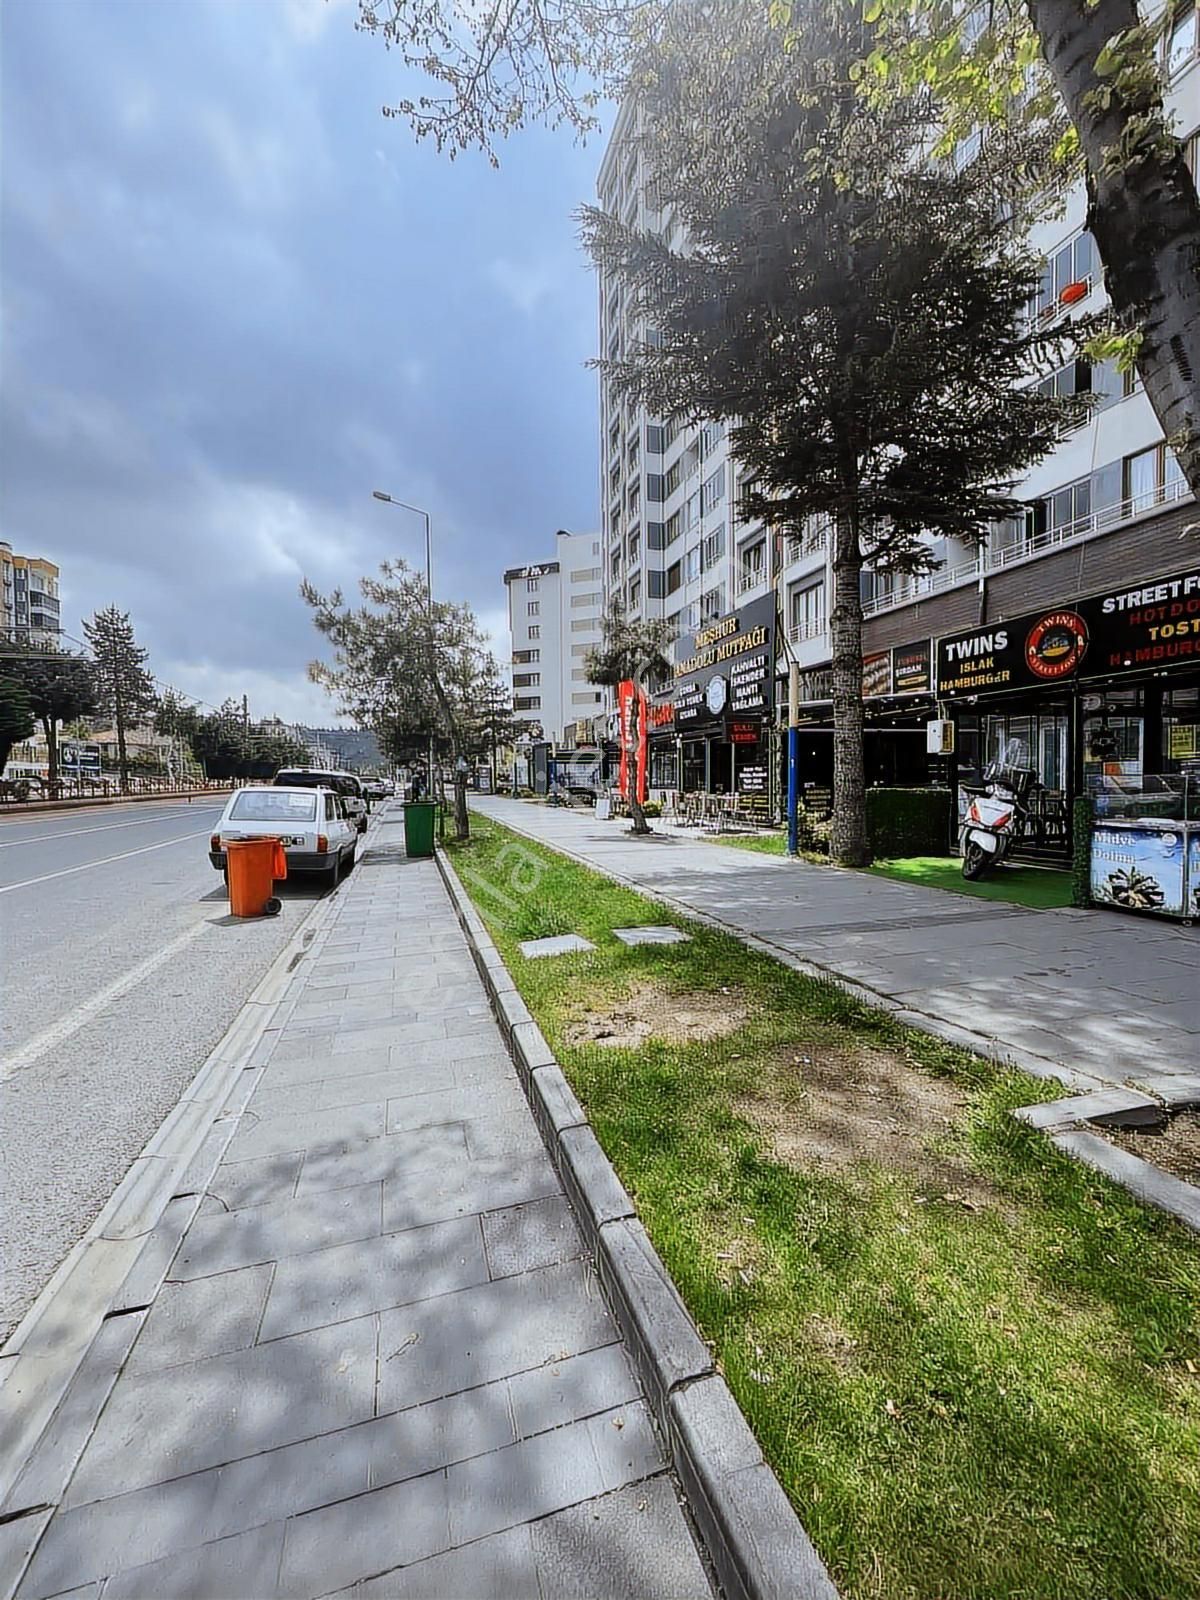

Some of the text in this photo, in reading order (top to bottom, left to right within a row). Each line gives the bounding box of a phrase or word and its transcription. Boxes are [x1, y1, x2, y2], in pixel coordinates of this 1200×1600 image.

[1102, 576, 1200, 613] STREETF
[1037, 615, 1074, 632] TWINS
[674, 625, 766, 678] ANADOLU MUTFAĞI
[945, 631, 1009, 663] TWINS
[731, 655, 765, 674] KAHVALTI
[960, 657, 994, 675] ISLAK
[939, 670, 1011, 692] HAMBURGER
